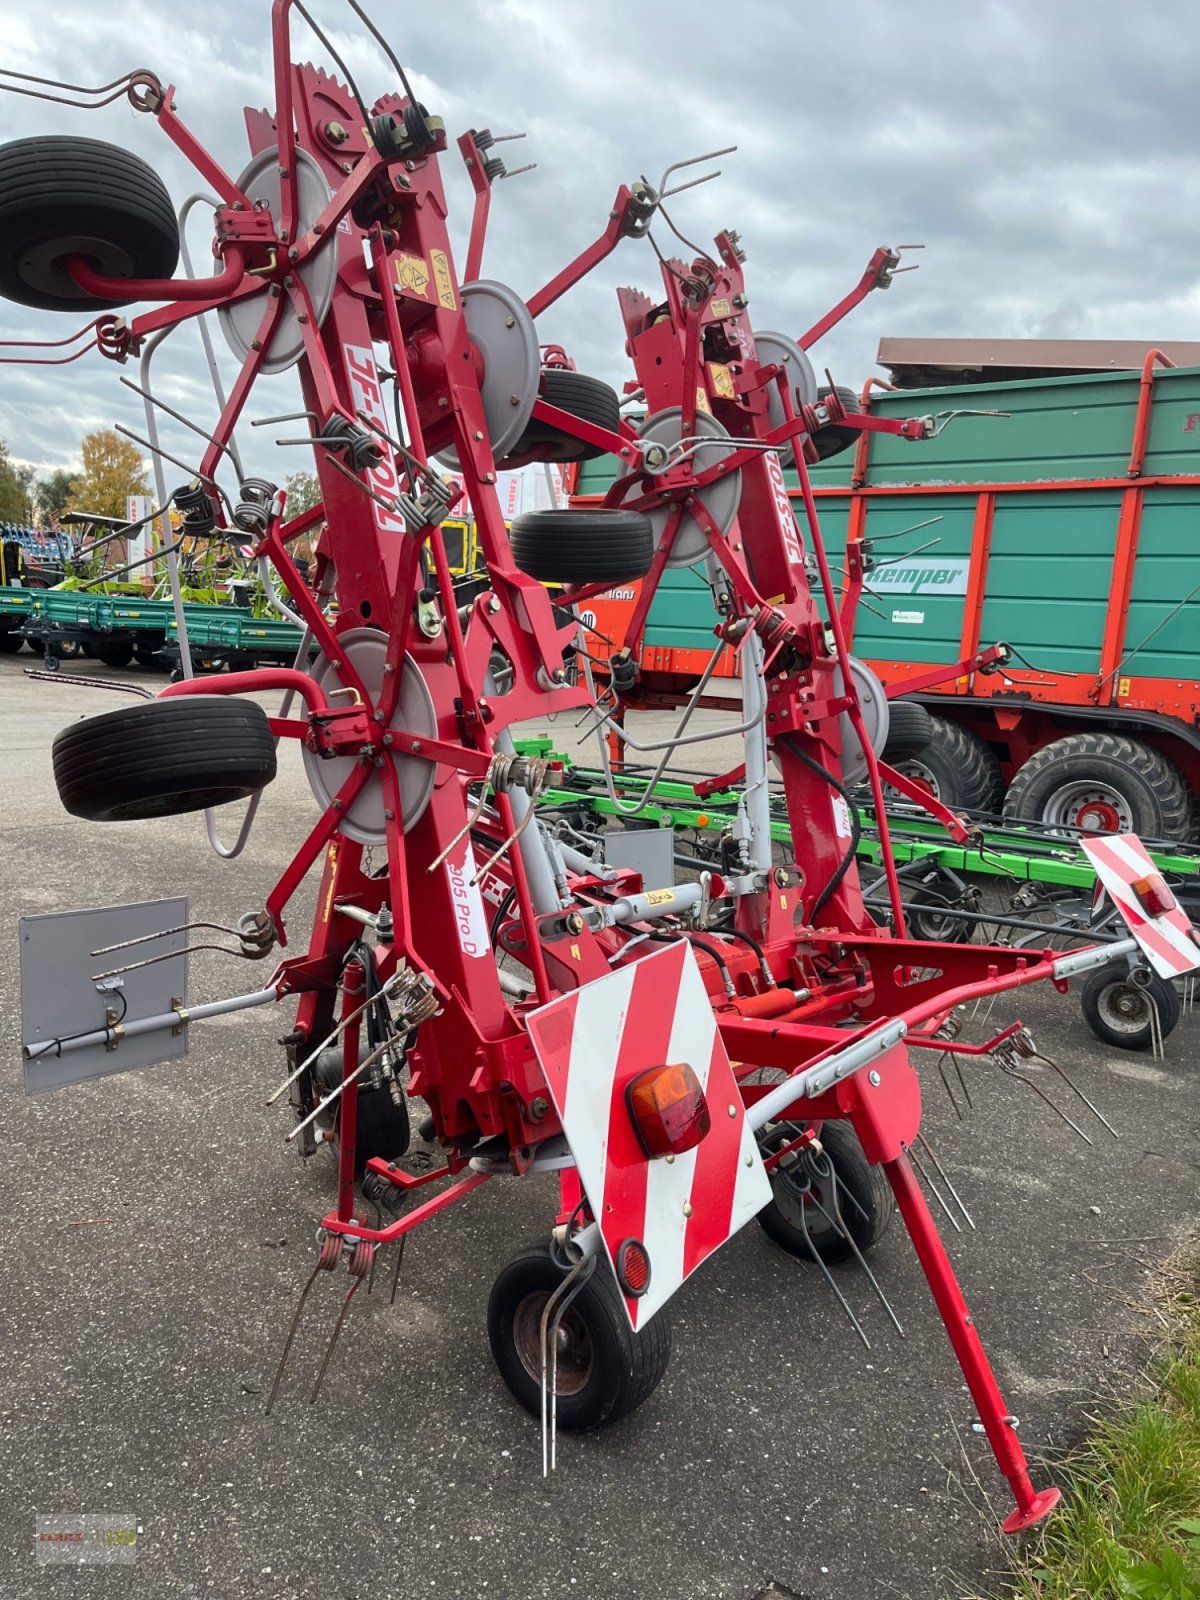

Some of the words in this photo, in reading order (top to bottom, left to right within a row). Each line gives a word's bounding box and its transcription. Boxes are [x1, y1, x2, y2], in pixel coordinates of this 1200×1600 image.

[765, 451, 801, 559] JF-STOL
[864, 568, 963, 593] kemper
[582, 614, 593, 627] 40
[457, 903, 470, 935] Pro
[463, 941, 477, 955] D
